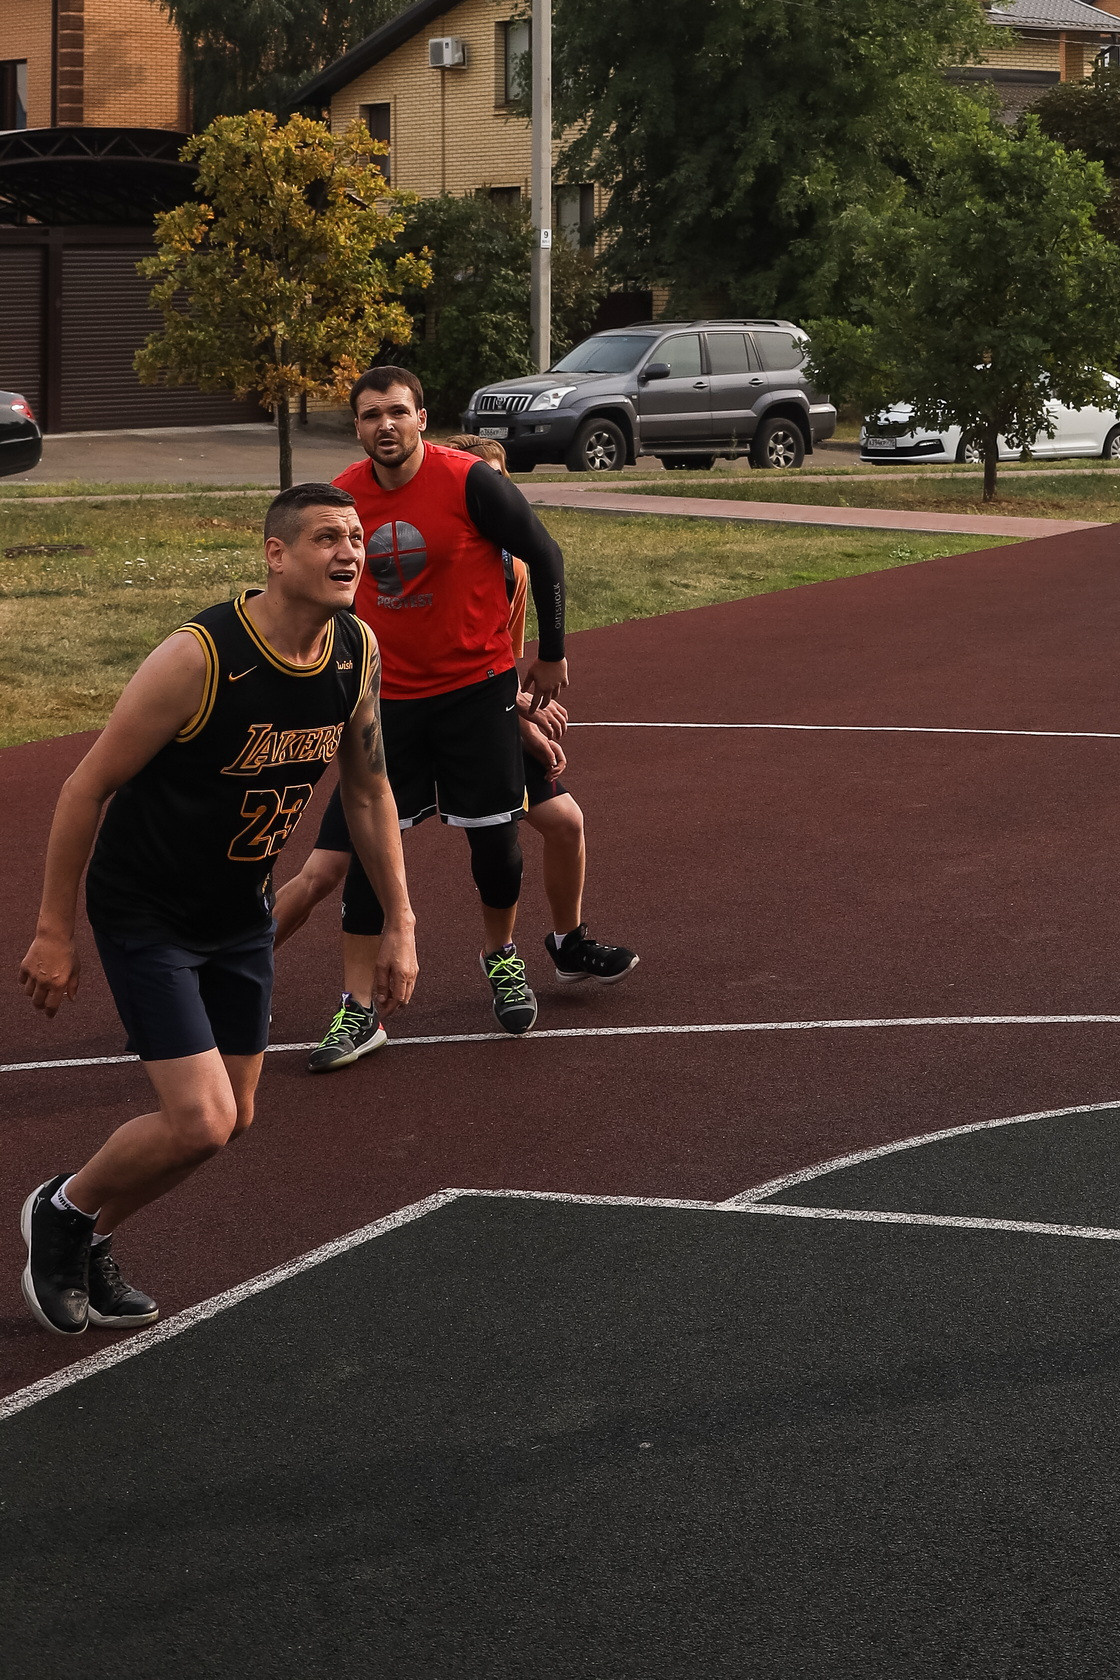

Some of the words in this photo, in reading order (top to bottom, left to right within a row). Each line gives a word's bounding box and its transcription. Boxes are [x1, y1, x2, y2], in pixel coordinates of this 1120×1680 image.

[543, 230, 549, 239] 9
[377, 592, 434, 610] PROTEST
[553, 582, 562, 630] OUTSHOCK
[335, 659, 354, 670] wish
